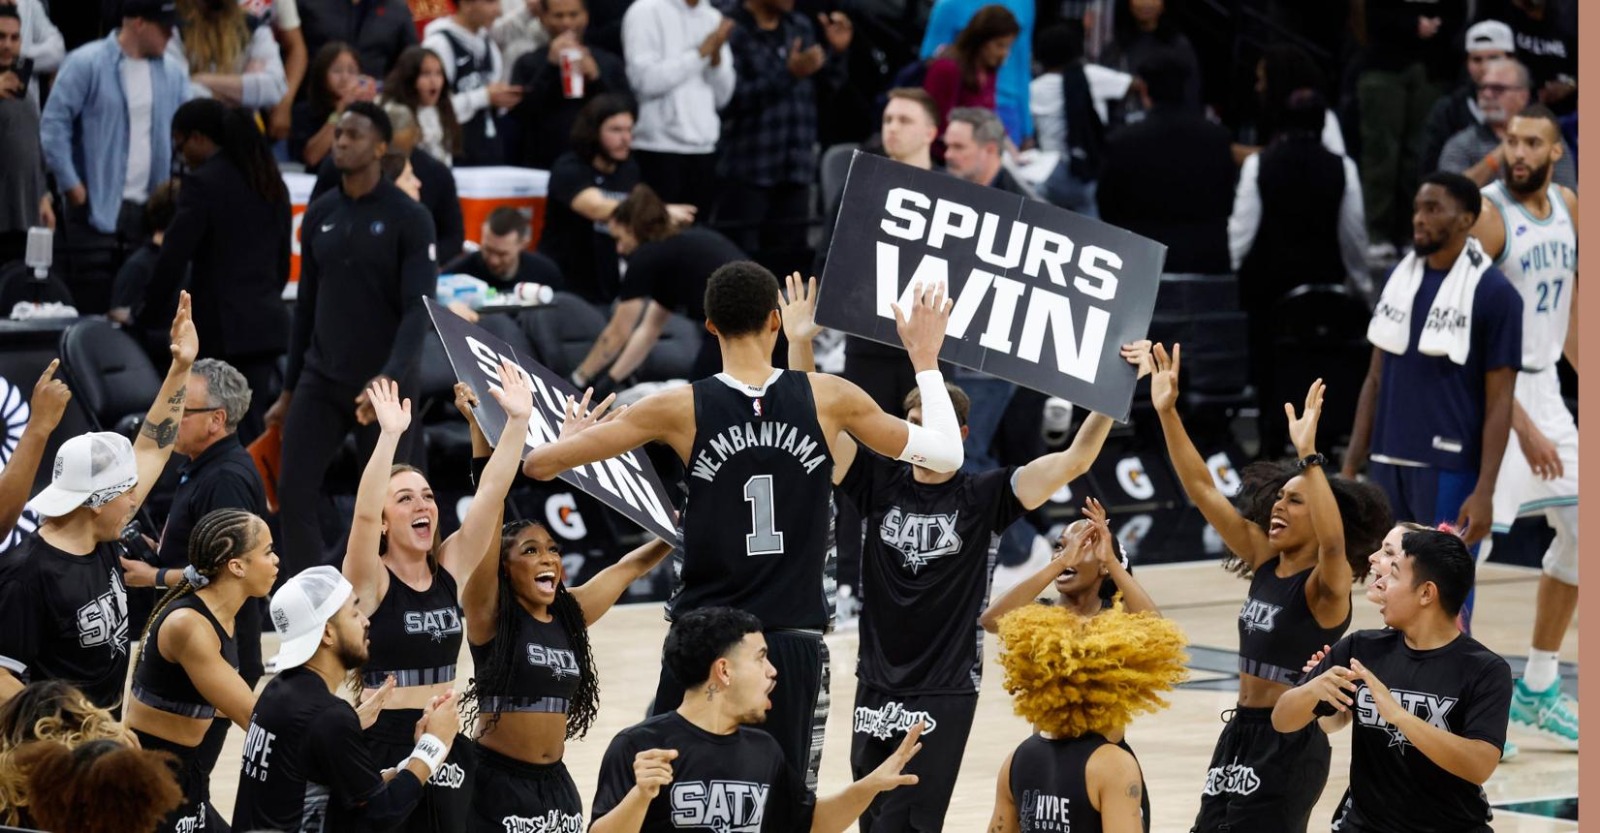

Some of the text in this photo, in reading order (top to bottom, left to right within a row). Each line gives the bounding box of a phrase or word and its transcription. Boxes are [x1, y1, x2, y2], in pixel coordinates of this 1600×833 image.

[880, 187, 1123, 301] SPURS
[876, 241, 1111, 384] WIN
[1536, 278, 1564, 313] 27
[691, 421, 827, 483] WEMBANYAMA
[1115, 456, 1155, 500] G
[545, 492, 587, 541] G
[743, 474, 784, 556] 1
[880, 505, 963, 556] SATX
[404, 606, 462, 634] SATX
[527, 643, 580, 676] SATX
[670, 780, 770, 829] SATX
[1034, 820, 1070, 833] SQUAD
[1035, 794, 1070, 824] HYPE
